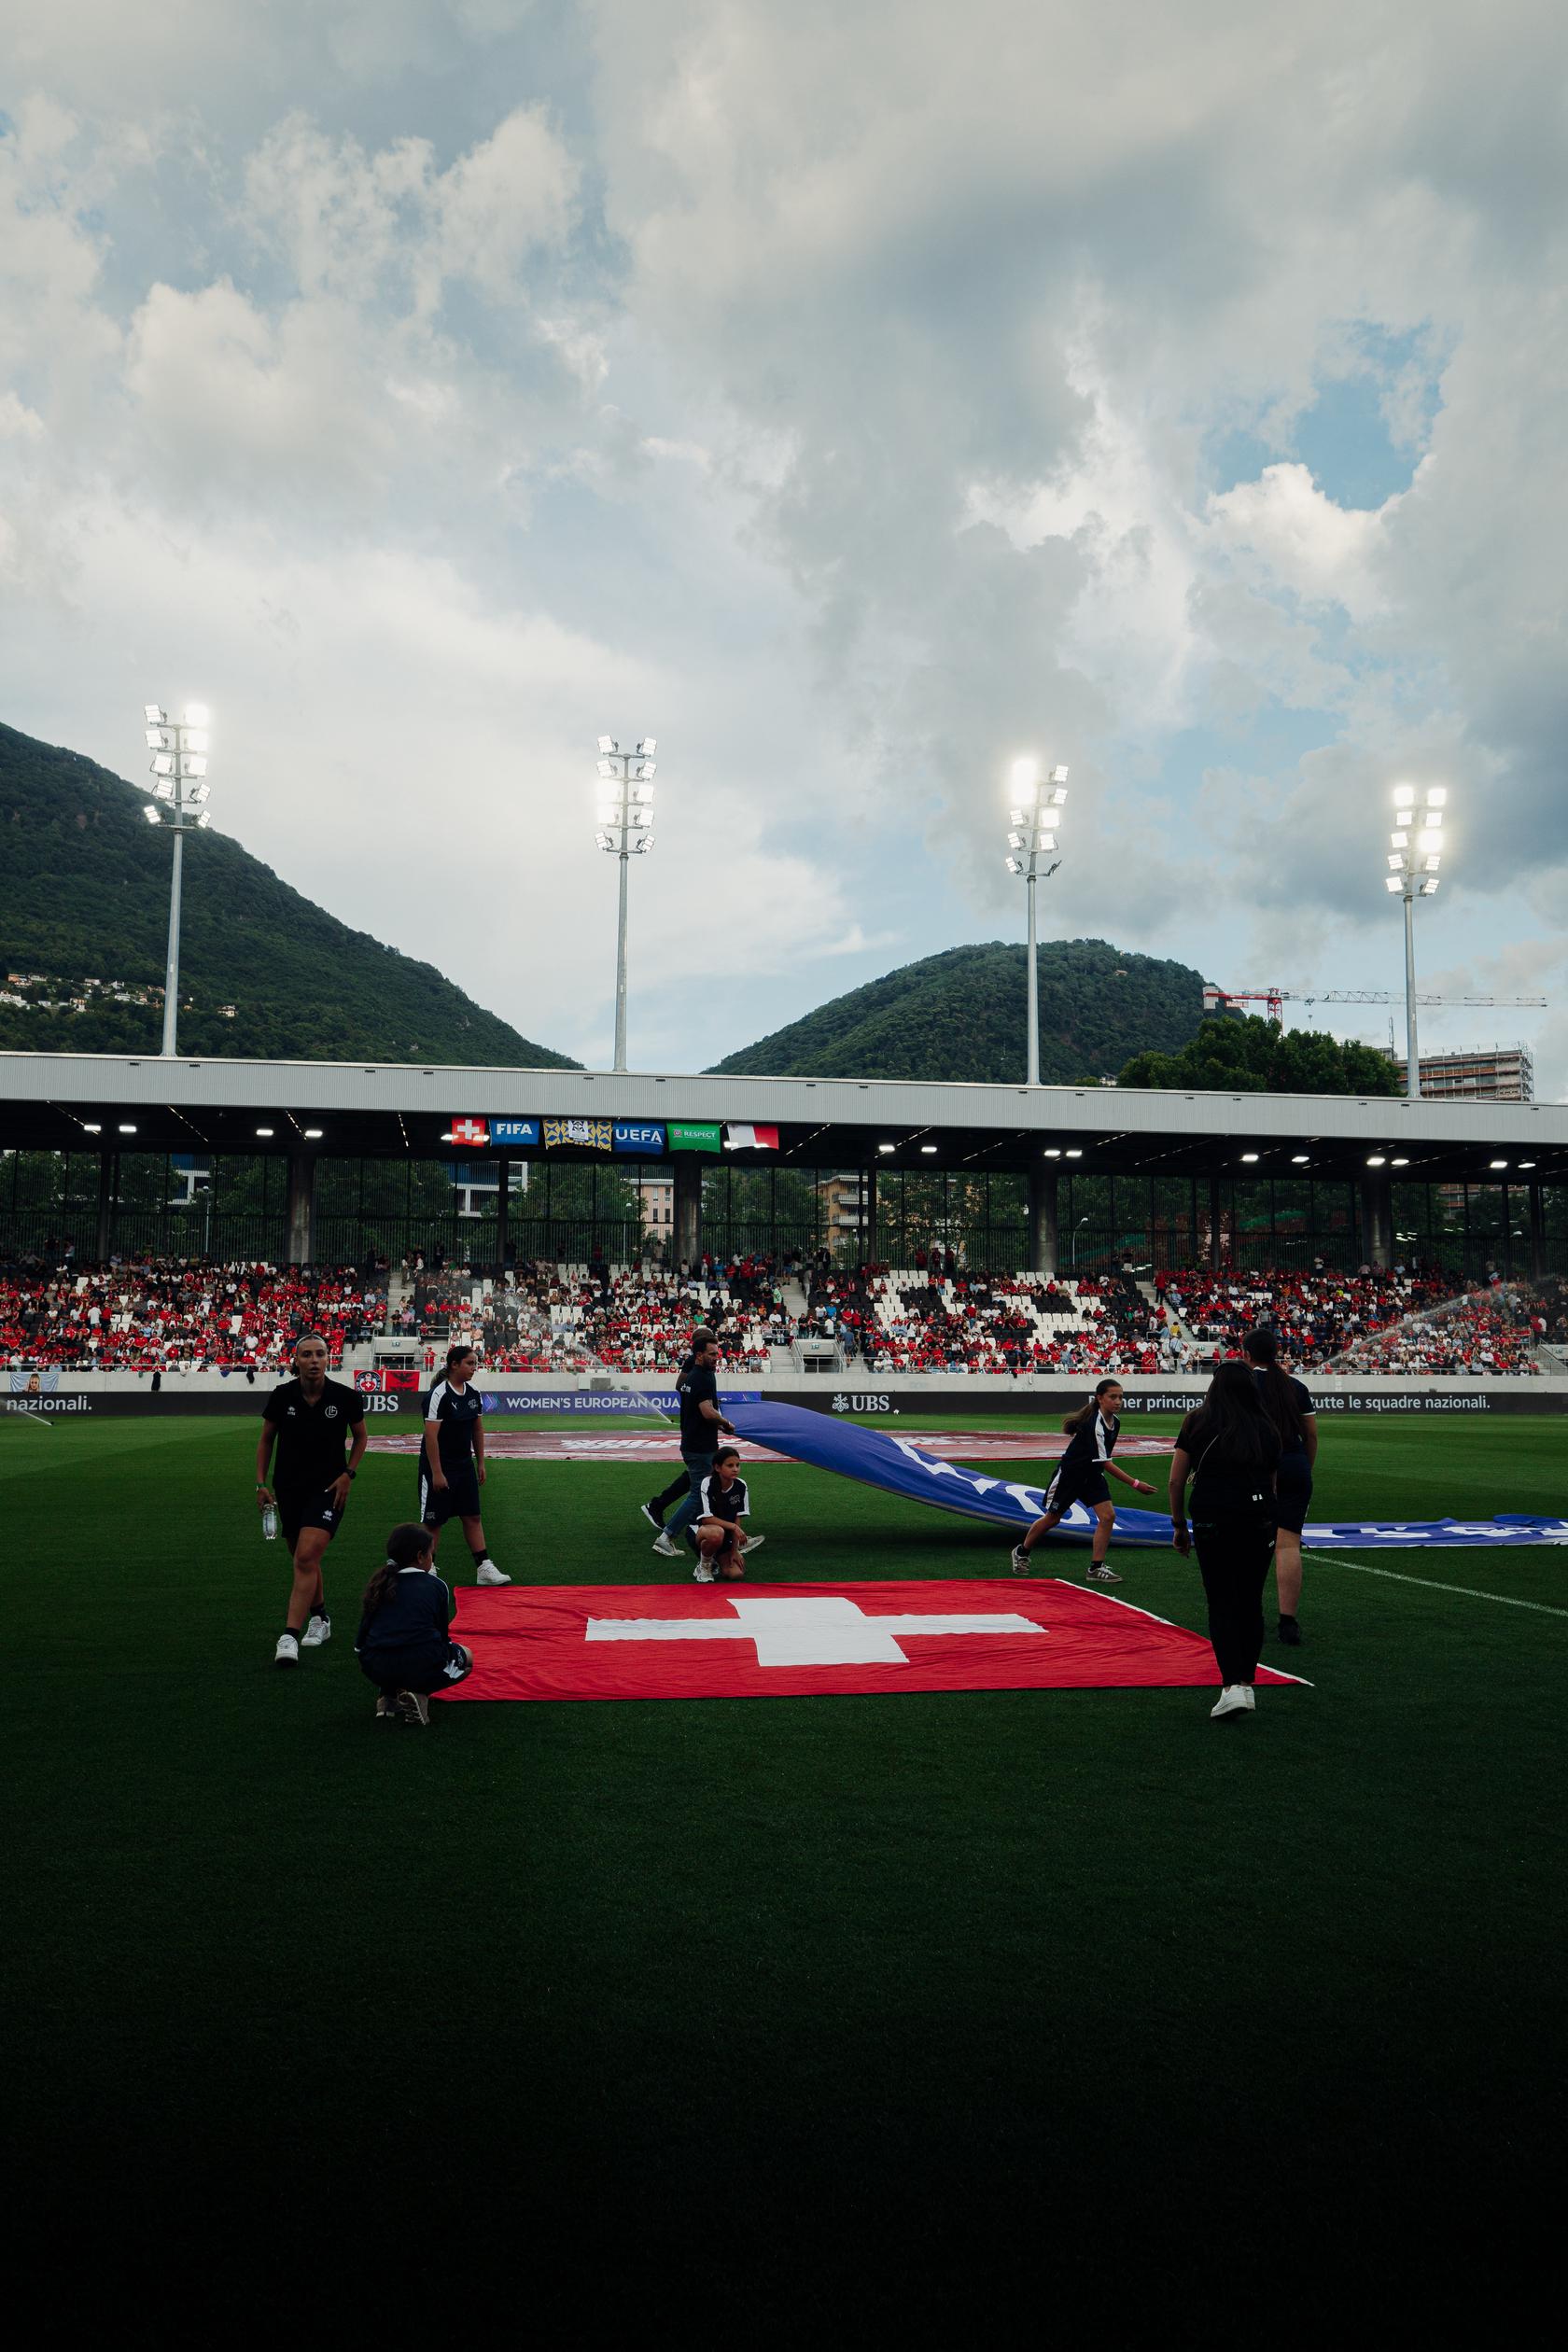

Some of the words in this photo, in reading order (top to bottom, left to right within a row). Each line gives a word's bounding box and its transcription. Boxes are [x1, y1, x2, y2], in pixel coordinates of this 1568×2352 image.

[496, 1123, 533, 1135] FIFA
[615, 1128, 663, 1143] UEFA
[683, 1129, 716, 1139] RESPECT
[506, 1397, 571, 1409] WOMEN'S
[574, 1397, 649, 1409] EUROPEAN
[851, 1394, 889, 1411] UBS
[1349, 1394, 1362, 1409] le
[1365, 1394, 1421, 1412] squadre
[1425, 1394, 1491, 1409] nazionali.
